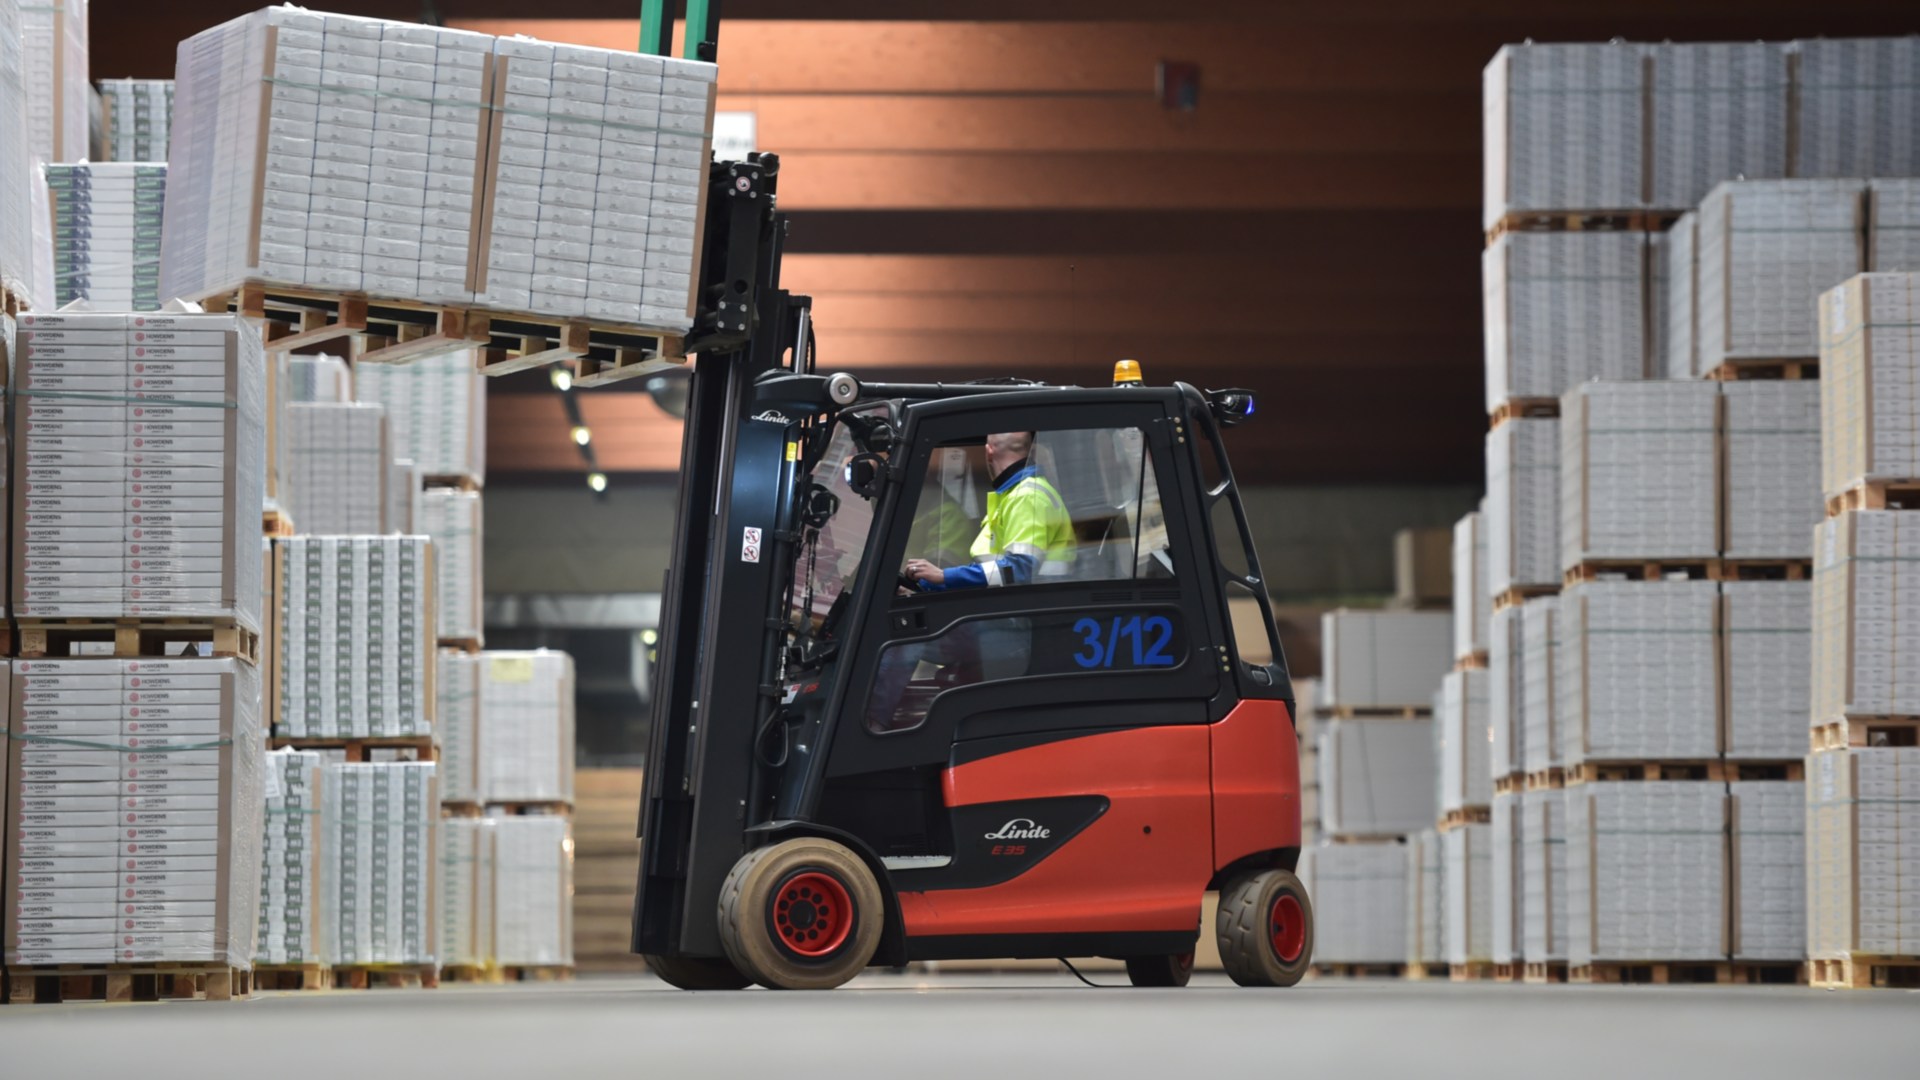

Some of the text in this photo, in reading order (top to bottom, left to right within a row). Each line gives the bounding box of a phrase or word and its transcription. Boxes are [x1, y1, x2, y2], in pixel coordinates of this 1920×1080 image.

[751, 410, 790, 425] Linde
[1073, 616, 1174, 668] 3/12
[984, 818, 1051, 840] Linde
[991, 845, 1026, 855] E 35
